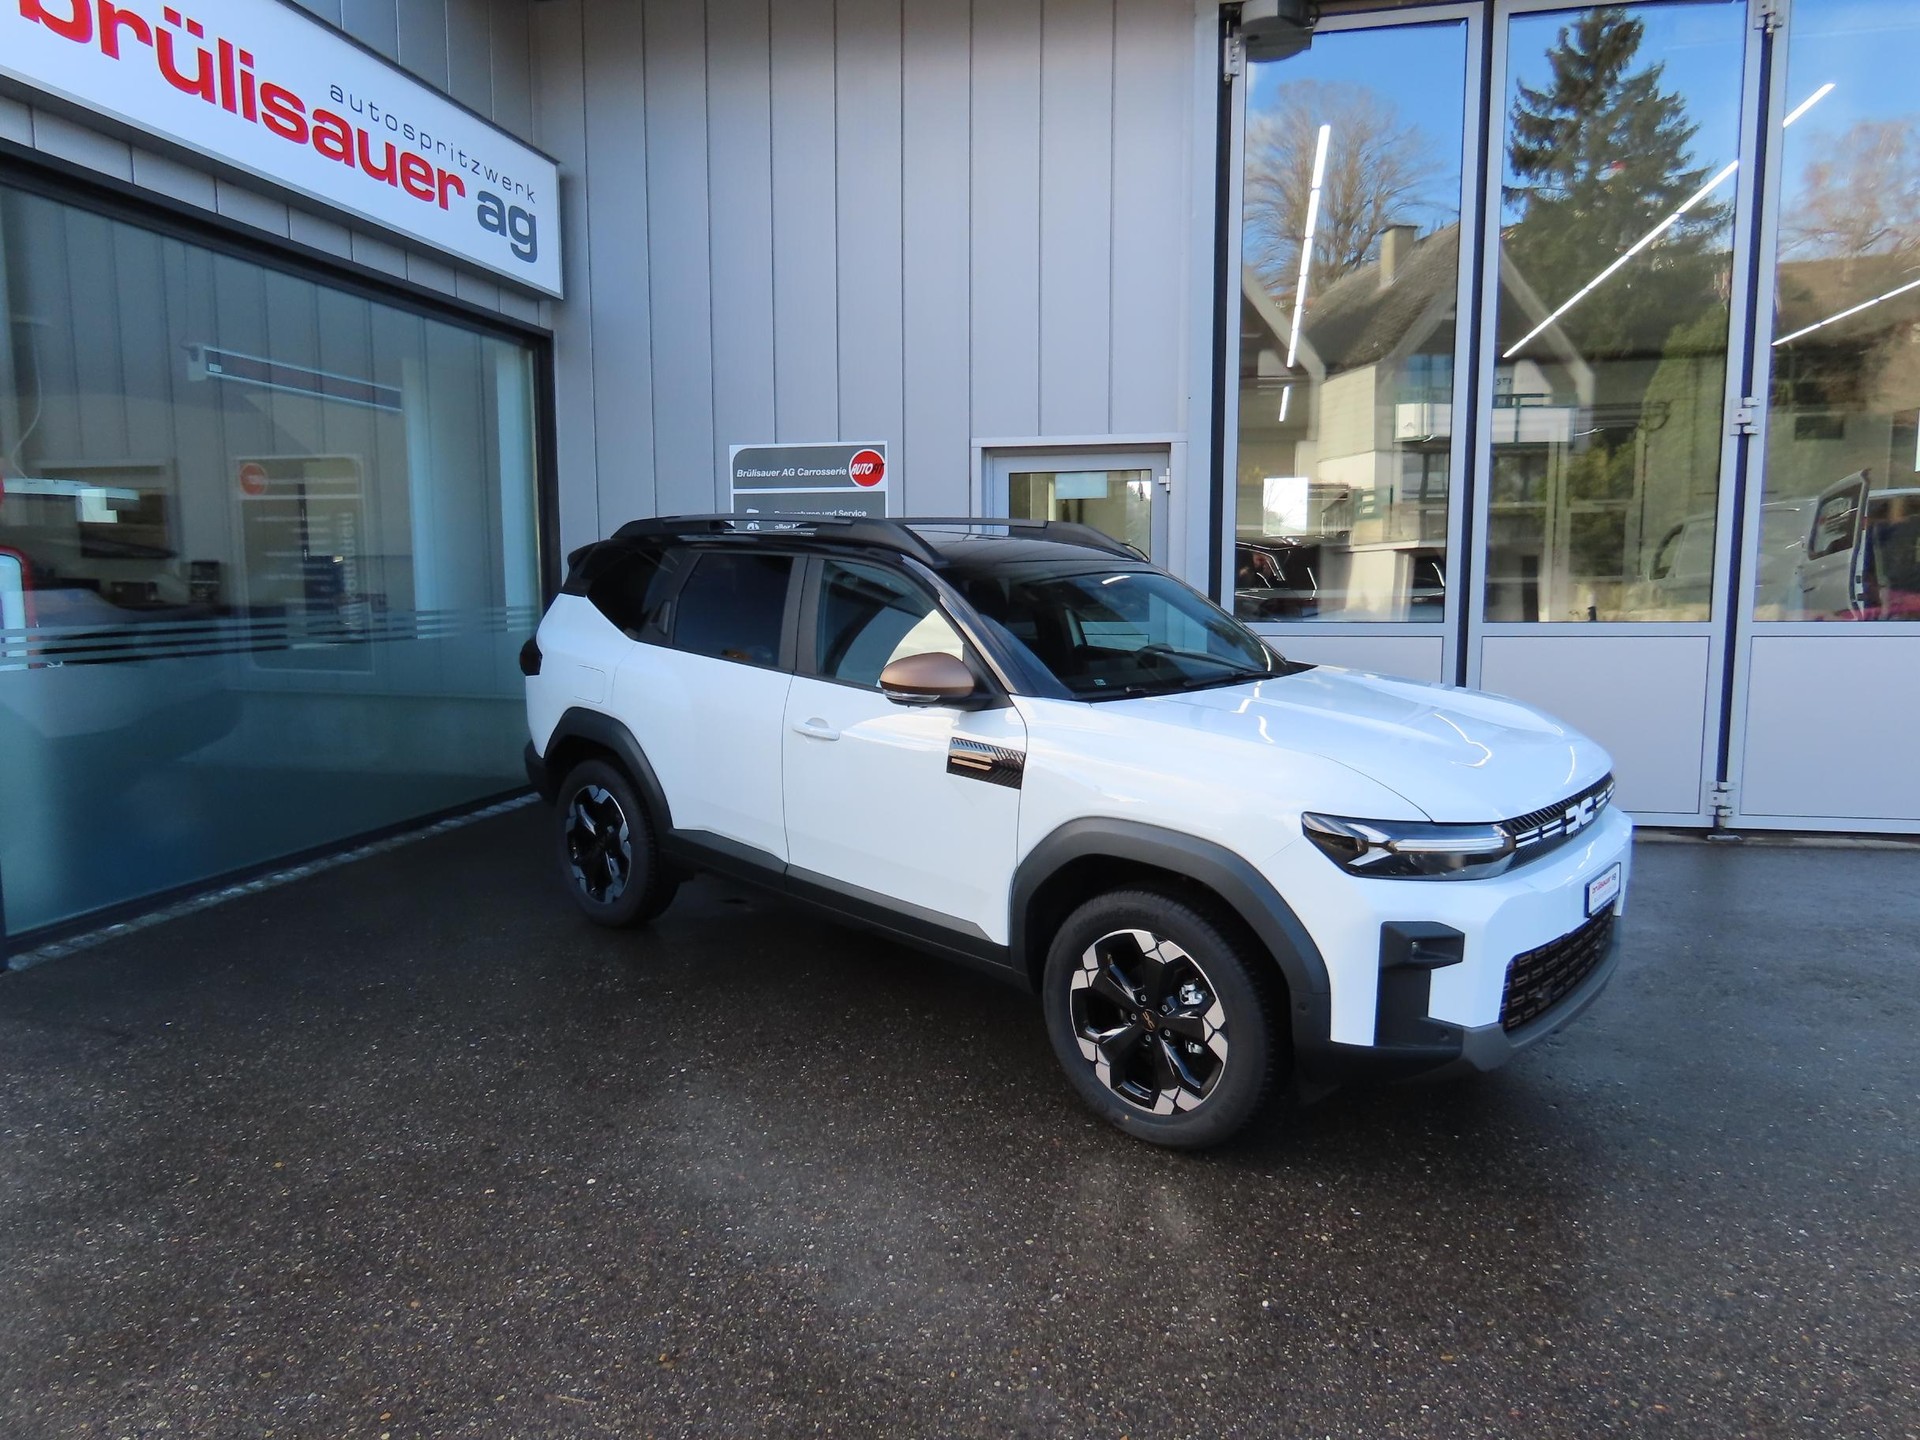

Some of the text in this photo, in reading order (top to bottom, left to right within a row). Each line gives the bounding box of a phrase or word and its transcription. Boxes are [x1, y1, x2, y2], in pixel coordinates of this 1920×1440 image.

[329, 82, 536, 204] autospritzwerk
[477, 190, 538, 263] ag
[736, 467, 847, 478] Brülisauer AG Carrosserie
[838, 509, 867, 517] Service
